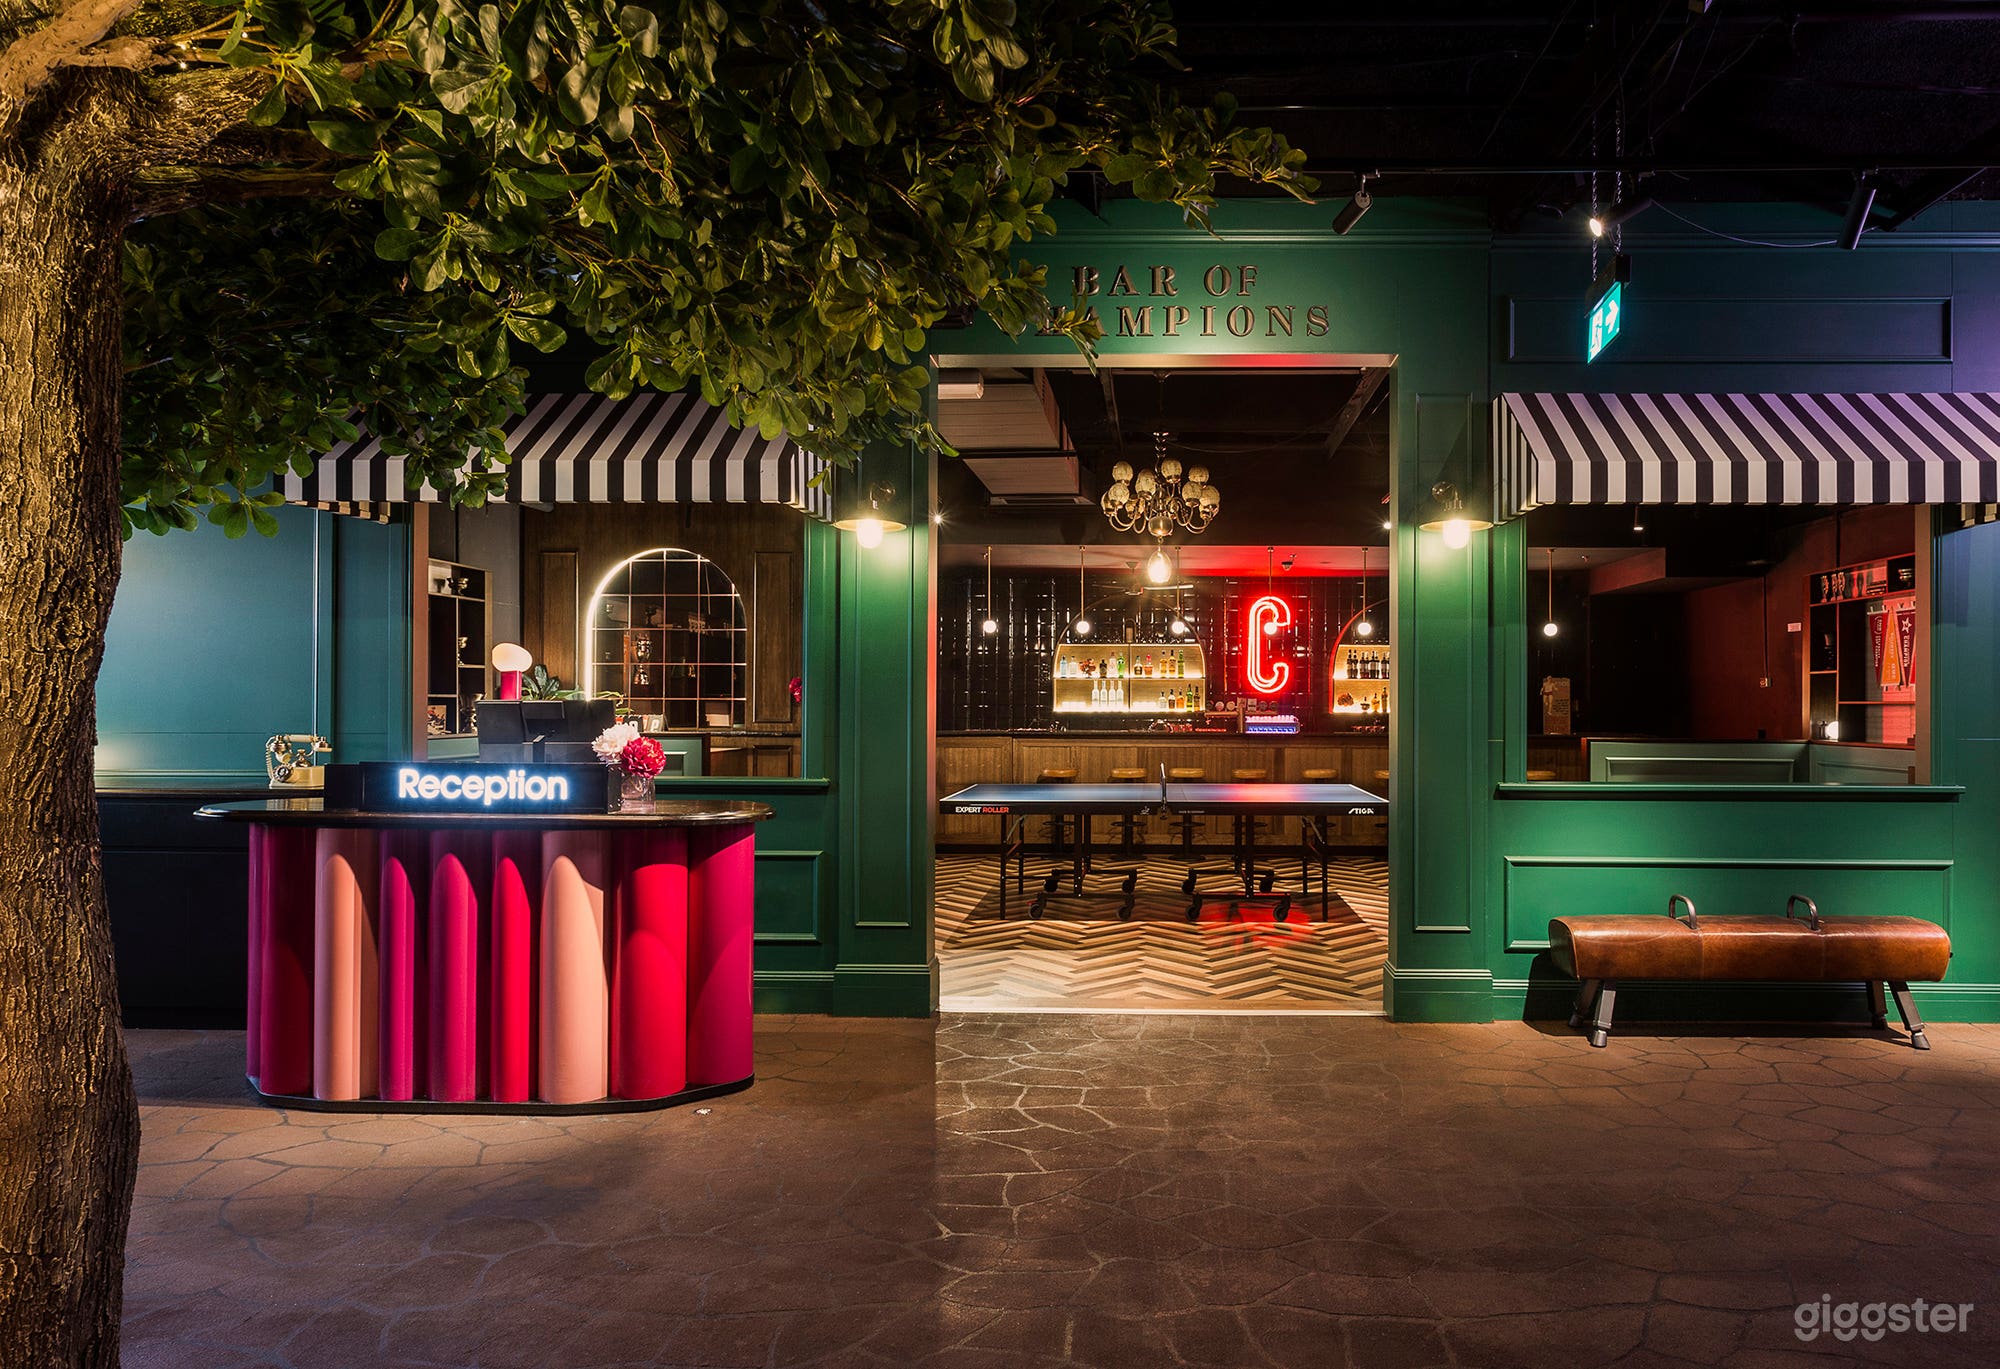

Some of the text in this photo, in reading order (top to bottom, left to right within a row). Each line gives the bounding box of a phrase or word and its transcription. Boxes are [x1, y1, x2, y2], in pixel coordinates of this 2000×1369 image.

[1071, 264, 1259, 297] BAR OF
[398, 768, 568, 806] Reception
[1348, 807, 1374, 815] STIGA
